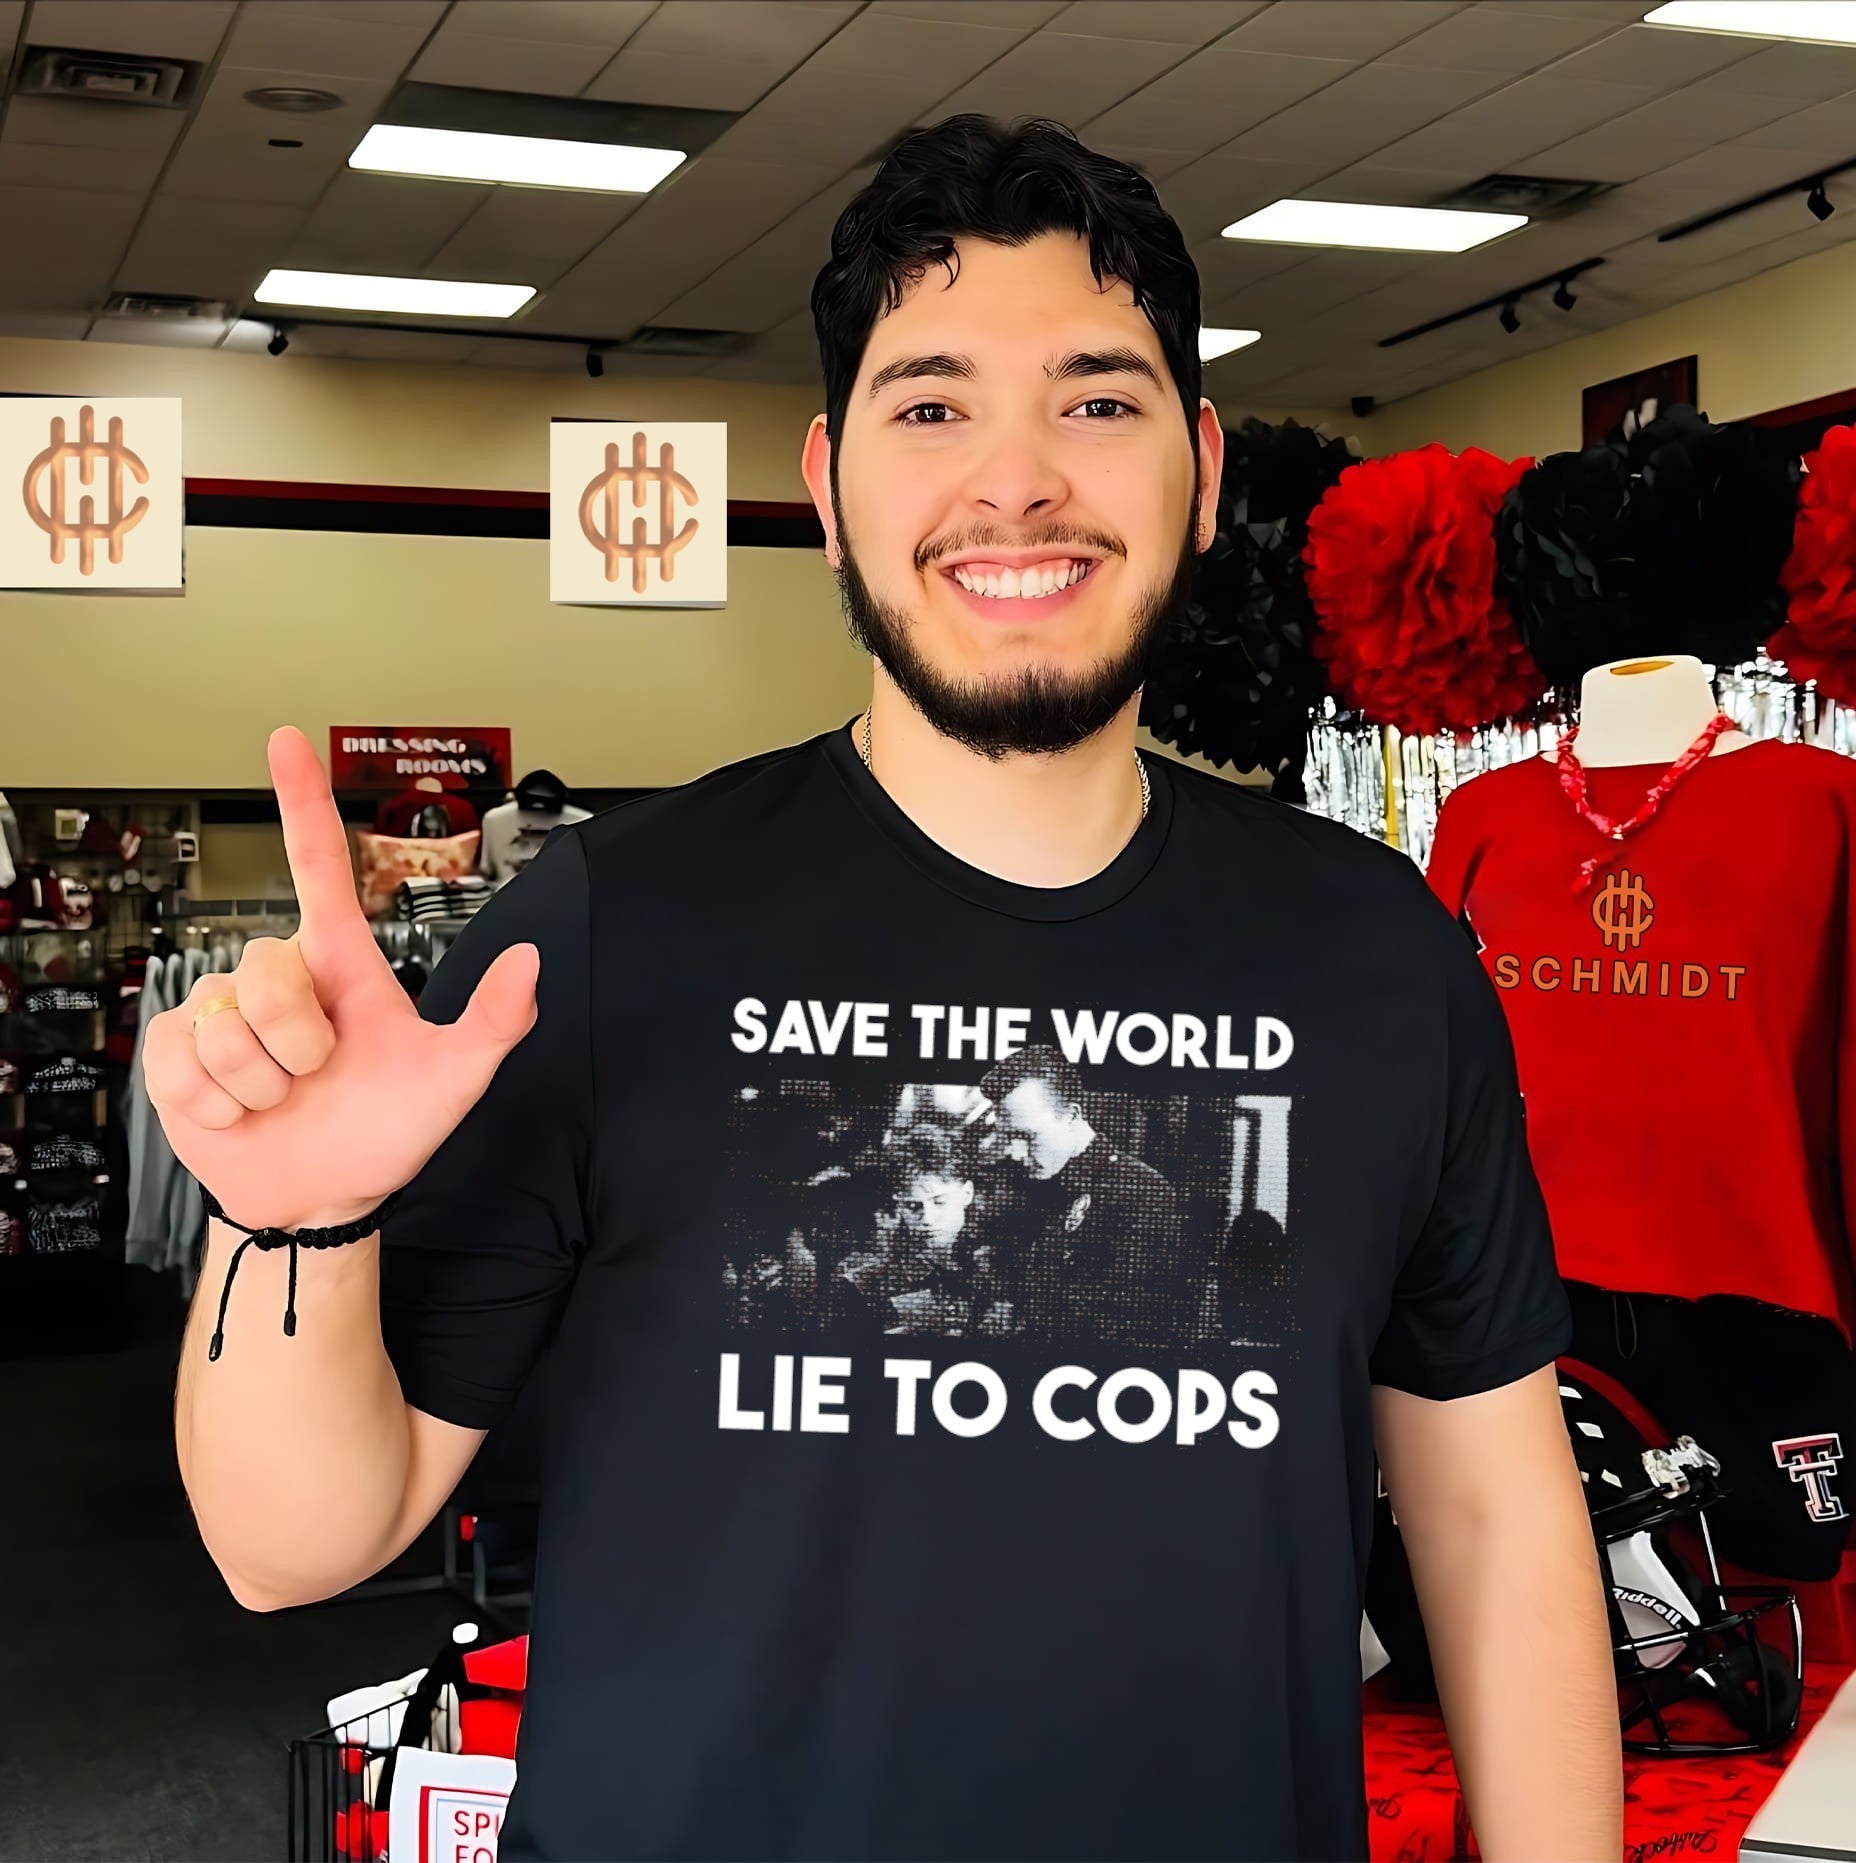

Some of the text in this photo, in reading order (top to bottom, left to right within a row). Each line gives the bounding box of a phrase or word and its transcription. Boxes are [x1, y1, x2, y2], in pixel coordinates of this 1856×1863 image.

[342, 737, 466, 754] DRESSING
[396, 758, 487, 775] ROOMS
[1494, 954, 1747, 1000] SCHMIDT
[730, 997, 1294, 1071] SAVE THE WORLD
[718, 1353, 1280, 1450] LIE TO COPS
